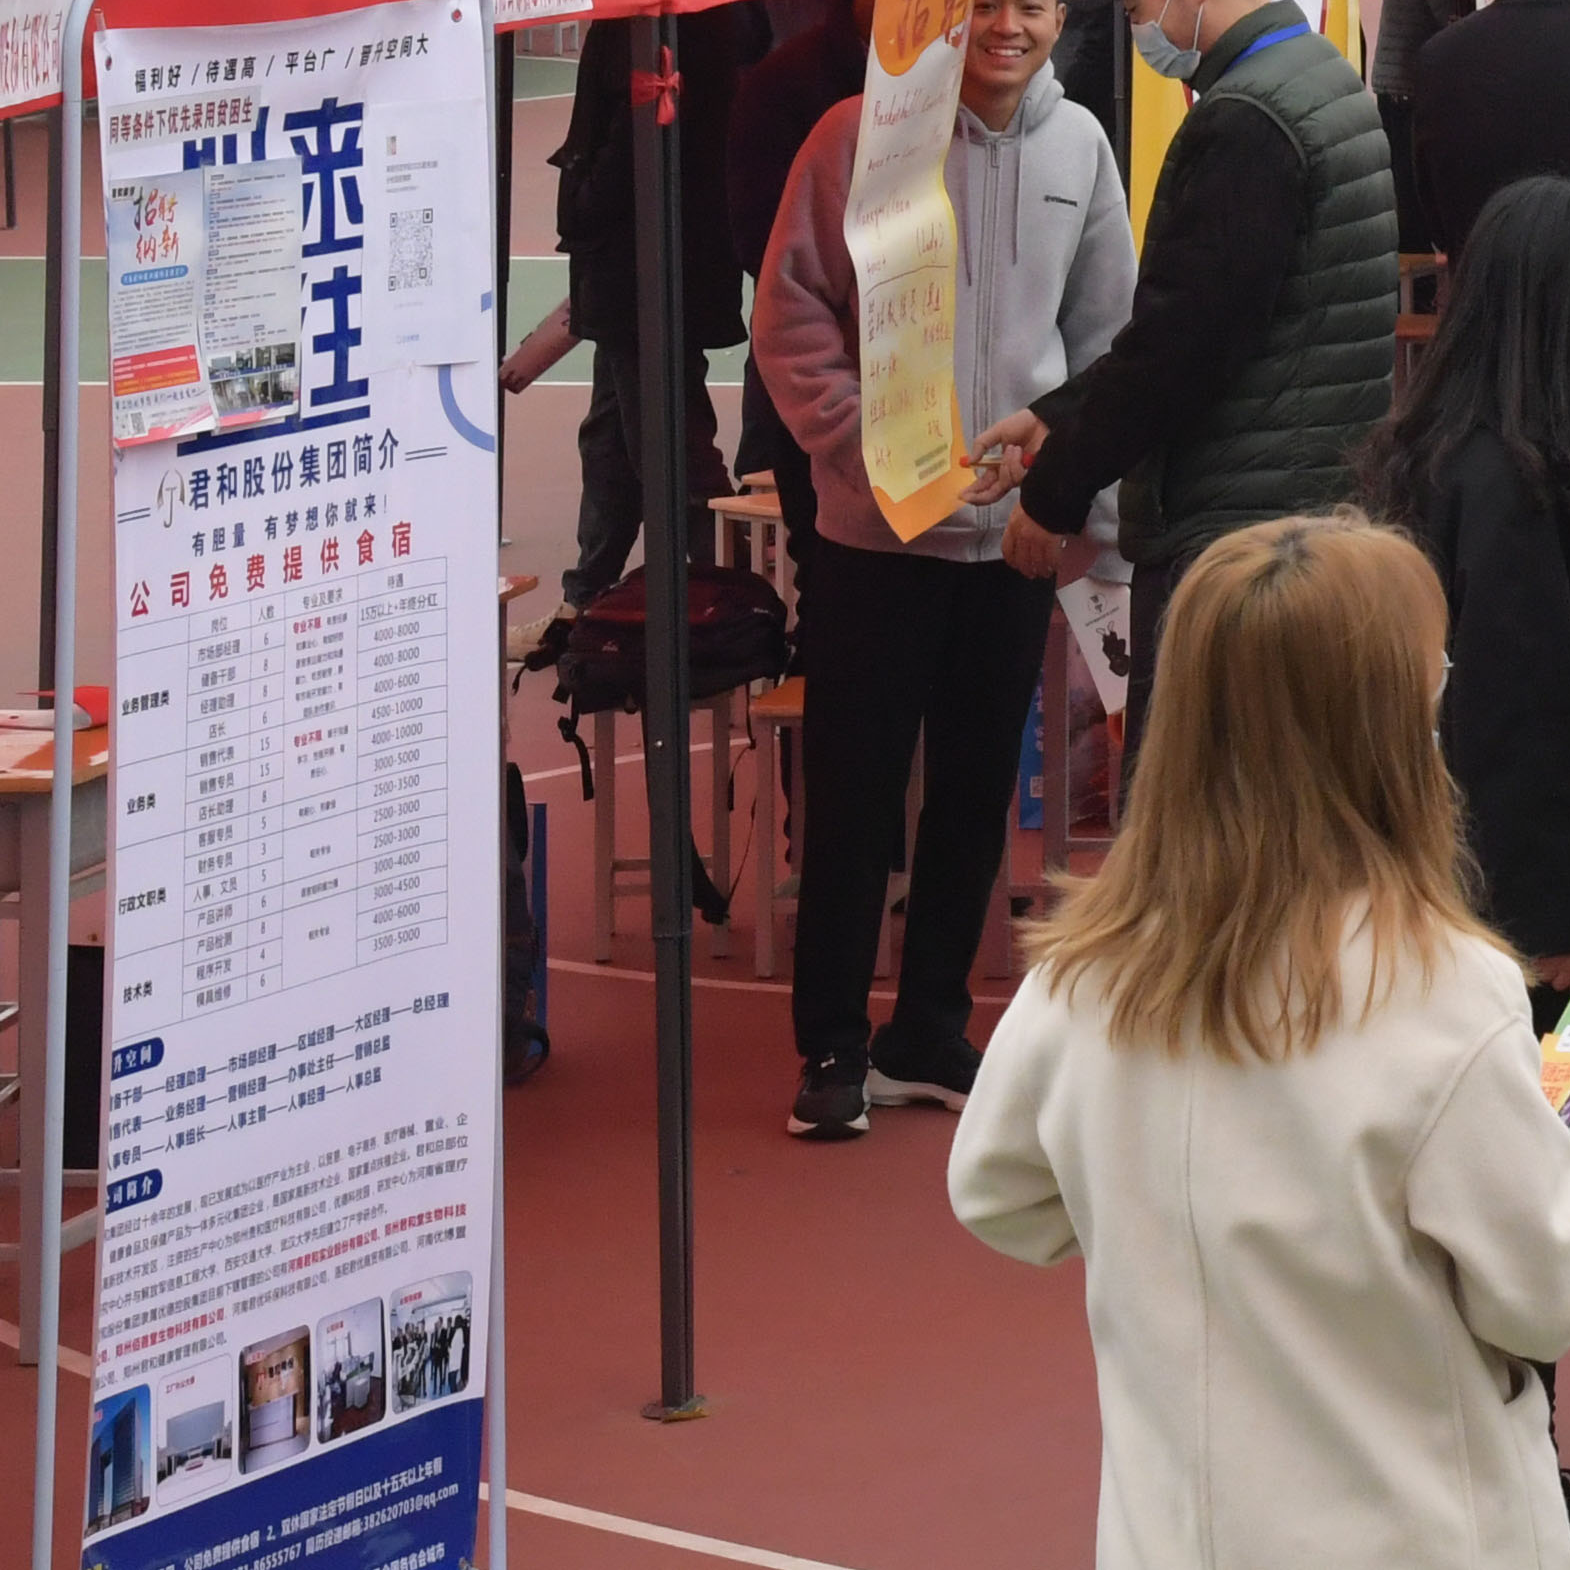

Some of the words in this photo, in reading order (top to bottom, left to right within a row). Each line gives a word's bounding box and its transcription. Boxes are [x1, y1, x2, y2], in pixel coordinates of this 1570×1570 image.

[135, 64, 181, 94] 福利好
[205, 55, 257, 85] 待遇高
[284, 47, 336, 75] 平台广
[359, 32, 429, 68] 晋升空间大
[109, 93, 253, 145] 同等条件下优先录用贫困生
[188, 428, 399, 511] 君和股份集团简介
[192, 522, 246, 557] 有胆量
[130, 521, 412, 618] 公司免费提供食宿
[263, 633, 270, 646] 6
[373, 621, 420, 642] 4000-8000
[373, 647, 420, 667] 4000-8000
[373, 673, 420, 693] 4000-6000
[121, 690, 170, 716] 业务管理类
[371, 697, 423, 719] 4500-10000
[262, 710, 268, 724] 6
[208, 723, 227, 739] 店长
[371, 723, 423, 745] 4000-10000
[260, 737, 271, 751] 15
[260, 764, 271, 777] 15
[373, 749, 421, 771] 3000-5000
[126, 793, 156, 815] 业务类
[373, 800, 420, 823] 2500-3000
[261, 816, 267, 830] 5
[373, 825, 420, 849] 2500-3000
[261, 842, 267, 856] 3
[373, 851, 420, 874] 3000-4000
[261, 869, 267, 882] 5
[373, 876, 420, 900] 3000-4500
[117, 887, 167, 915] 行政文职类
[261, 895, 267, 909] 6
[372, 902, 420, 925] 4000-6000
[373, 927, 421, 951] 3500-5000
[260, 948, 266, 961] 4
[123, 980, 153, 1004] 技术类
[260, 974, 266, 988] 6
